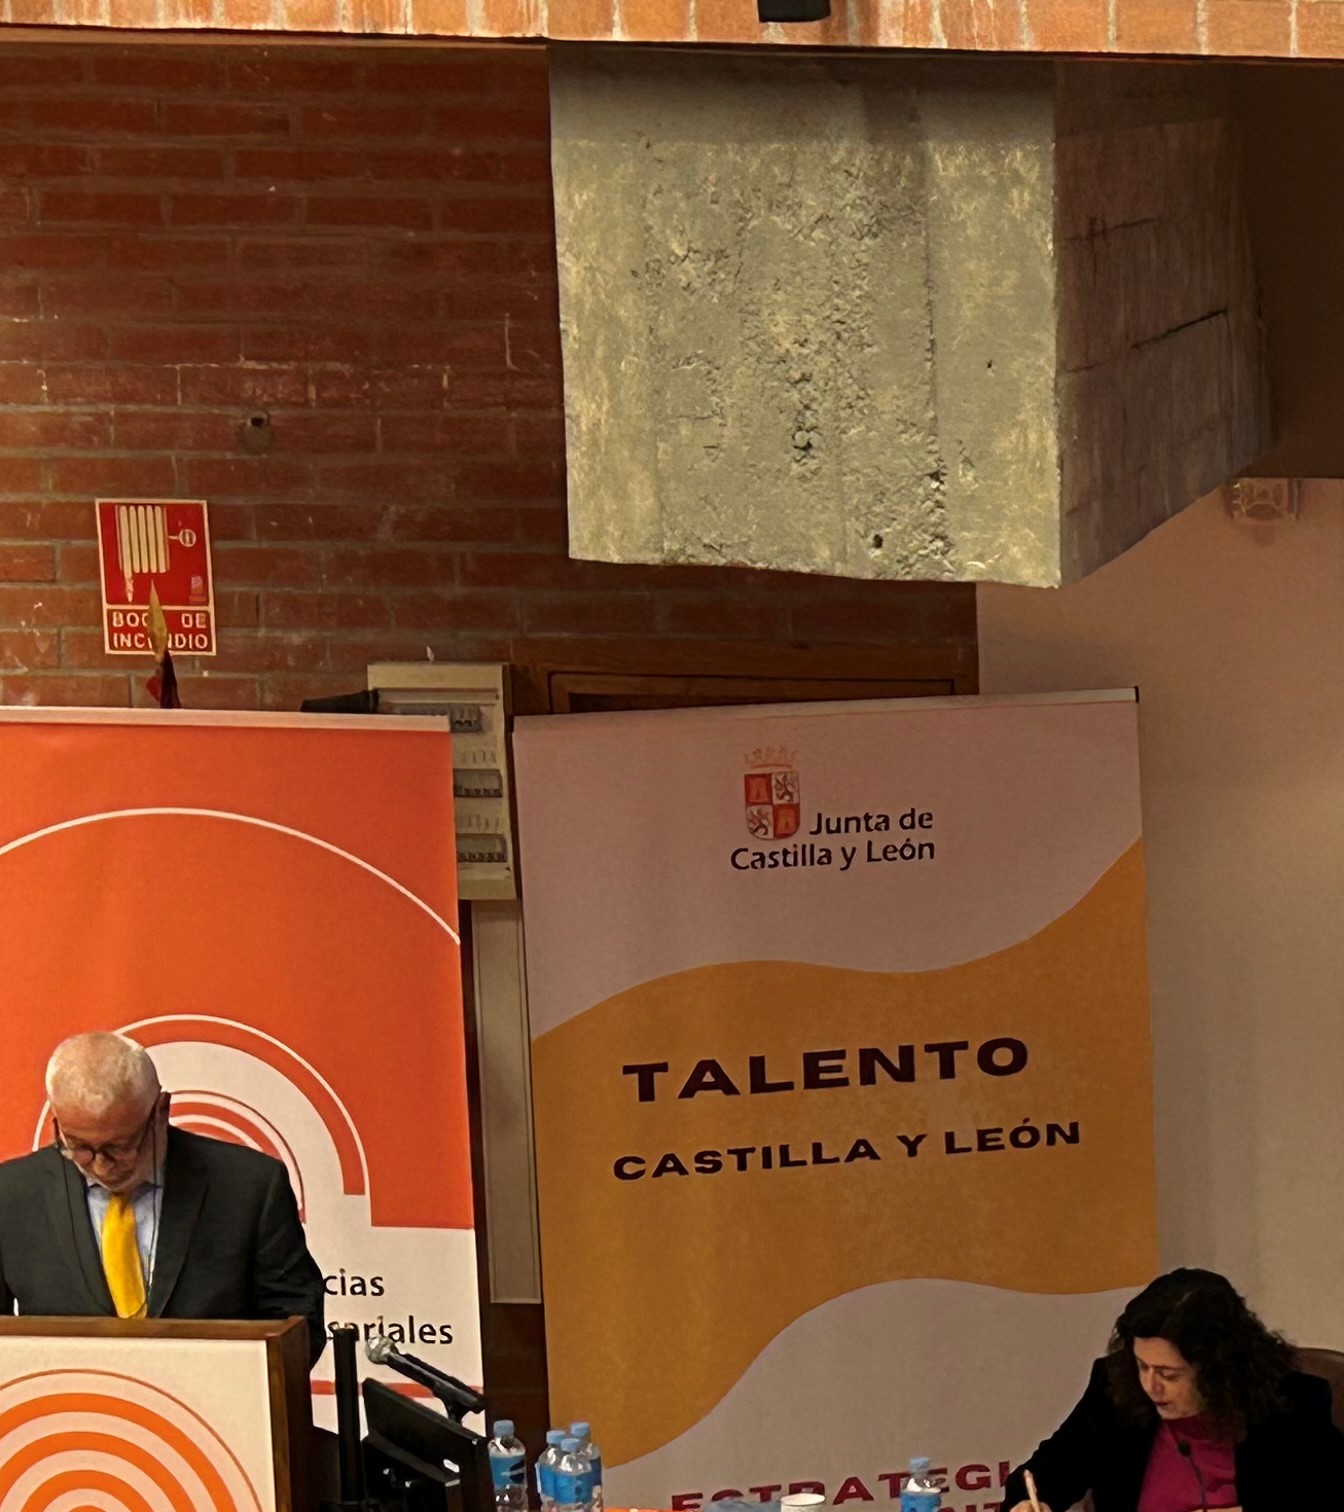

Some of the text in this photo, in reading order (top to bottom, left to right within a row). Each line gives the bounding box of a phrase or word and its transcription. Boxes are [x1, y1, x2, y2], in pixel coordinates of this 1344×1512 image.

[181, 612, 207, 629] DE
[809, 808, 934, 836] Junta de
[731, 838, 935, 871] Castilla y León
[622, 1037, 1029, 1102] TALENTO
[613, 1117, 1080, 1181] CASTILLA Y LEÓN
[324, 1268, 385, 1296] cias
